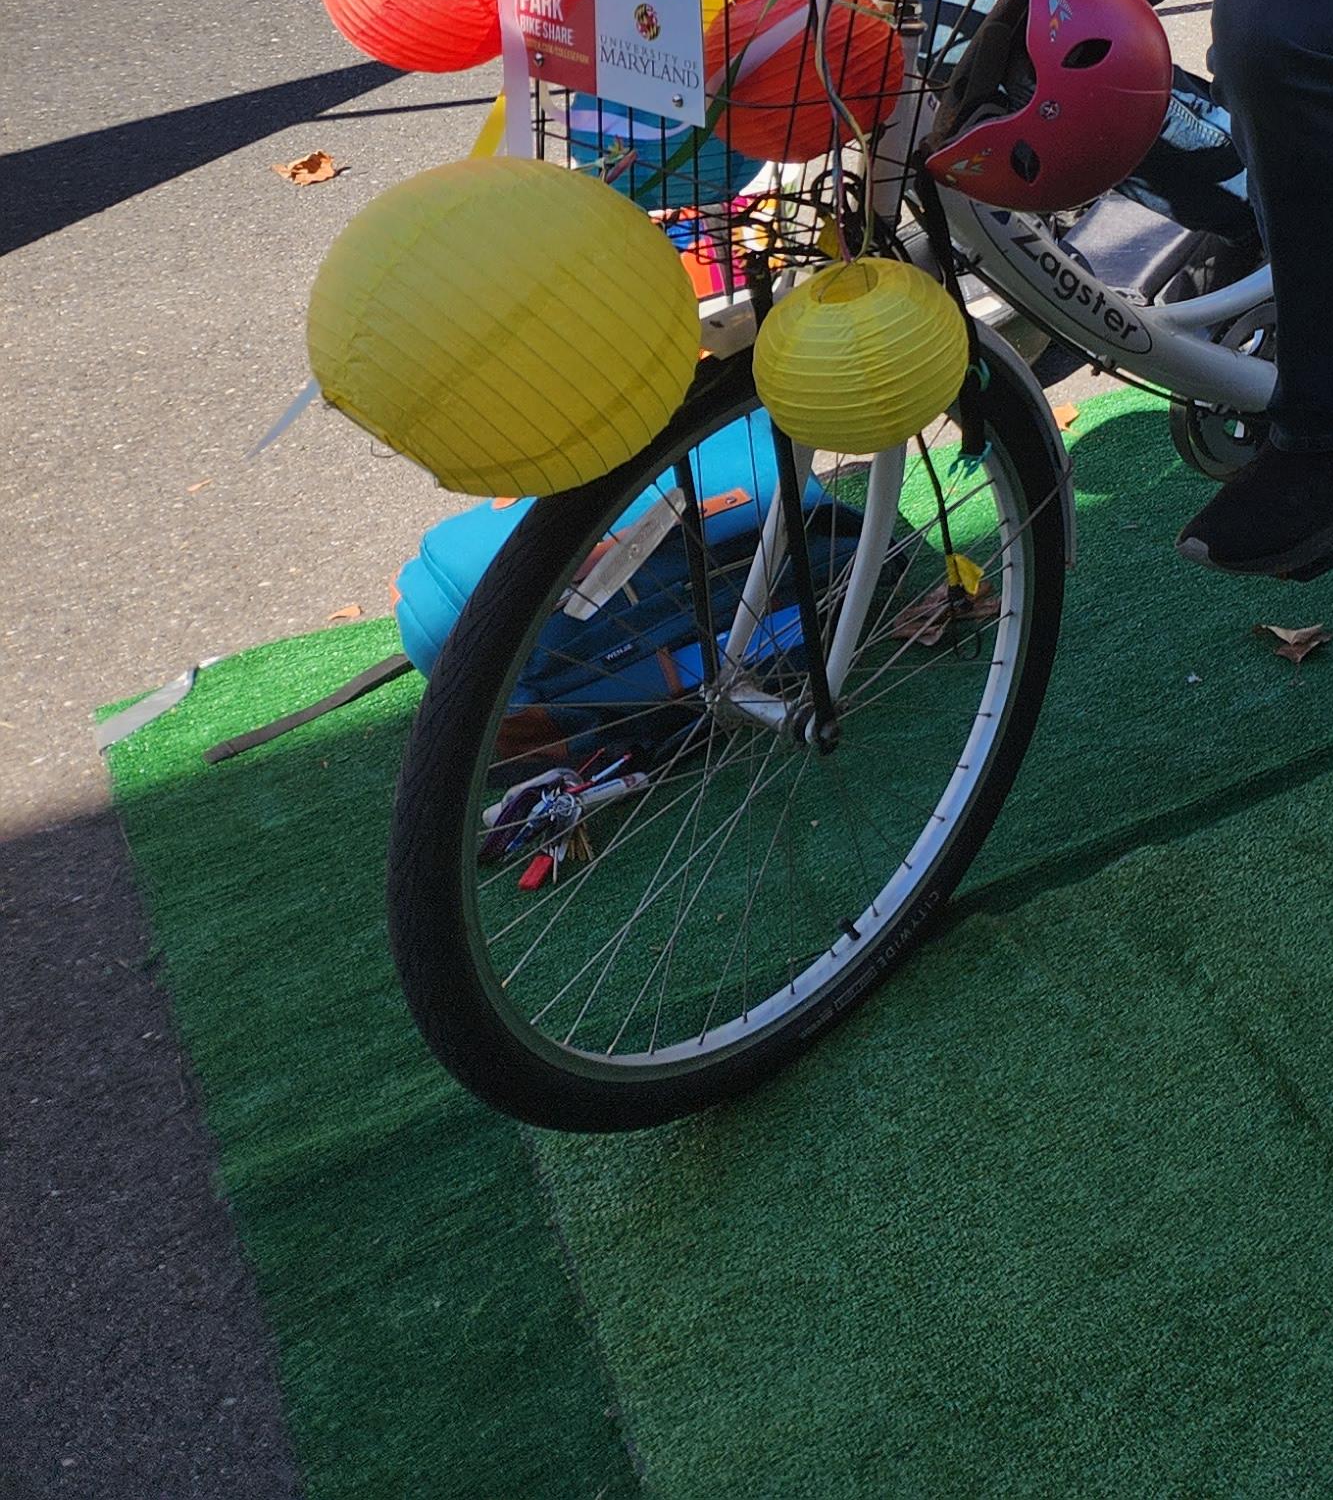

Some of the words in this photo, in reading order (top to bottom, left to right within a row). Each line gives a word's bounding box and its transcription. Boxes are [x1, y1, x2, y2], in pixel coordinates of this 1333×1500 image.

[521, 16, 541, 38] BIKE
[541, 24, 574, 46] SHARE
[600, 34, 679, 65] UNIVERSITY
[684, 59, 697, 71] OF
[600, 46, 699, 90] MARYLAND
[1011, 234, 1139, 341] Zagster
